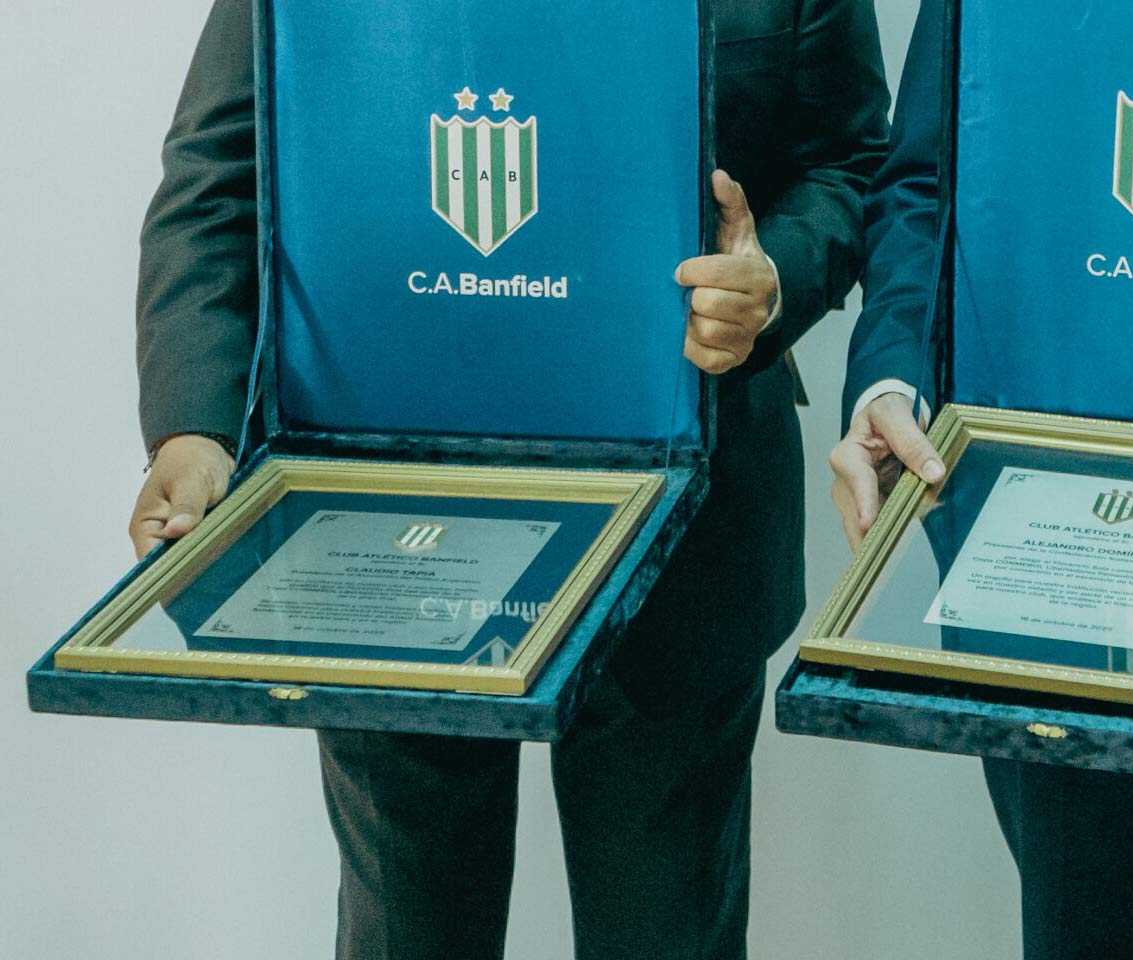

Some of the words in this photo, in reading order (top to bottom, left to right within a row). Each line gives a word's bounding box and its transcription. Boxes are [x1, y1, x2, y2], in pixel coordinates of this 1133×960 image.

[407, 271, 568, 299] C.A.Banfield
[1029, 522, 1060, 530] CLUB
[1022, 540, 1095, 552] ALEJANDRO
